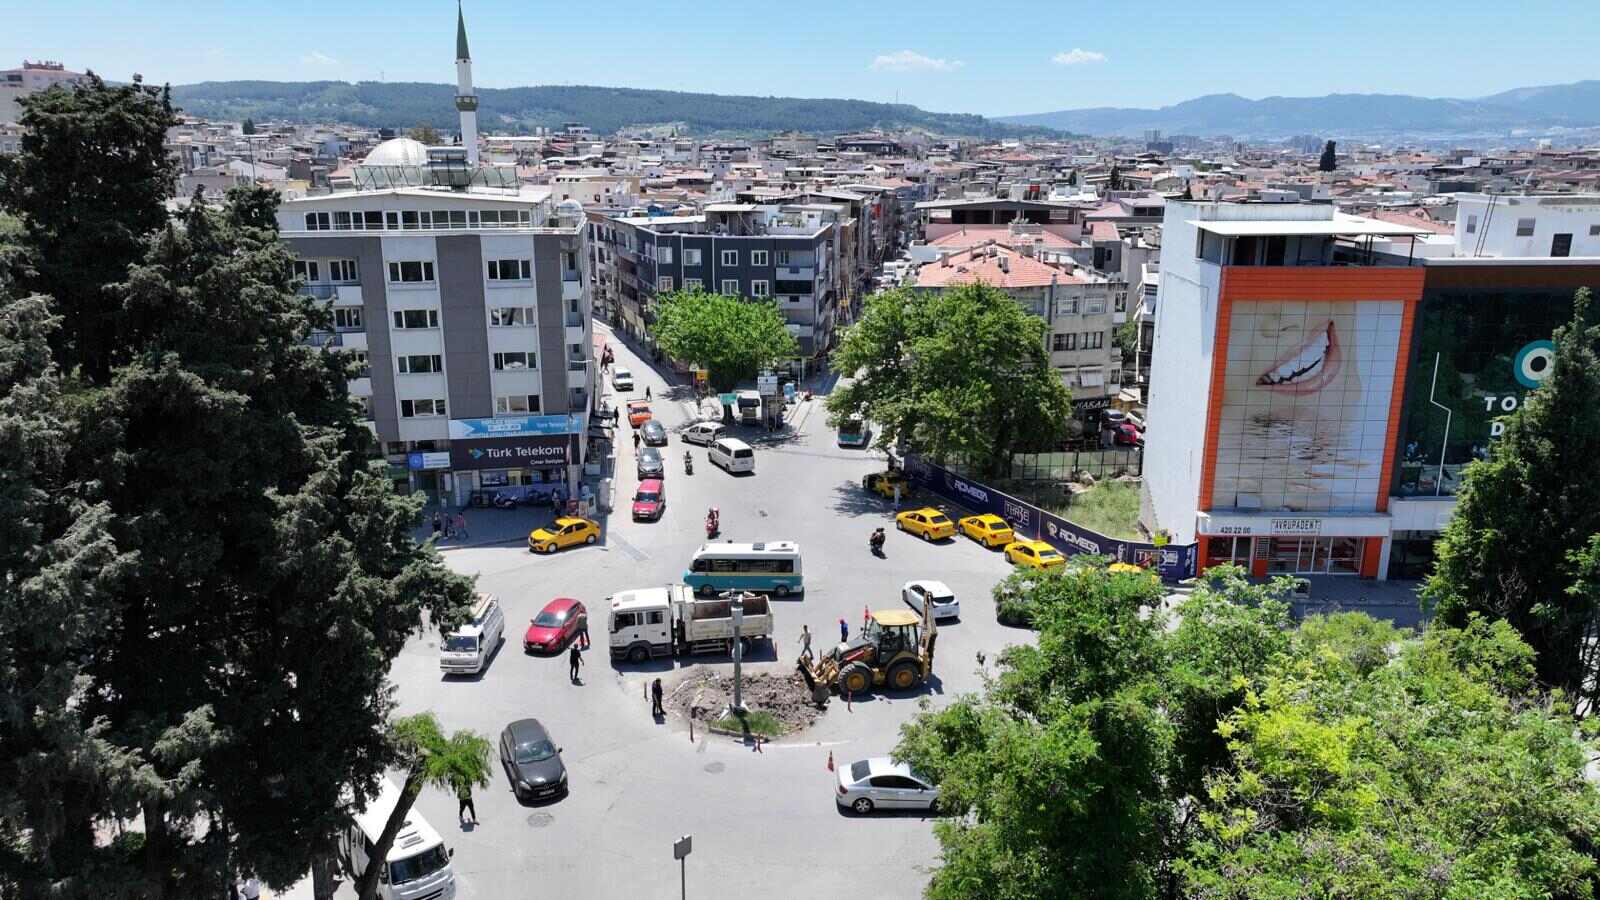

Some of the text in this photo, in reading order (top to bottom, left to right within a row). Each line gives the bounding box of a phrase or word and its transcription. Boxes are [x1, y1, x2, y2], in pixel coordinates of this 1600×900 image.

[486, 445, 564, 458] Türk Telekom
[1059, 528, 1100, 554] ROMEGA
